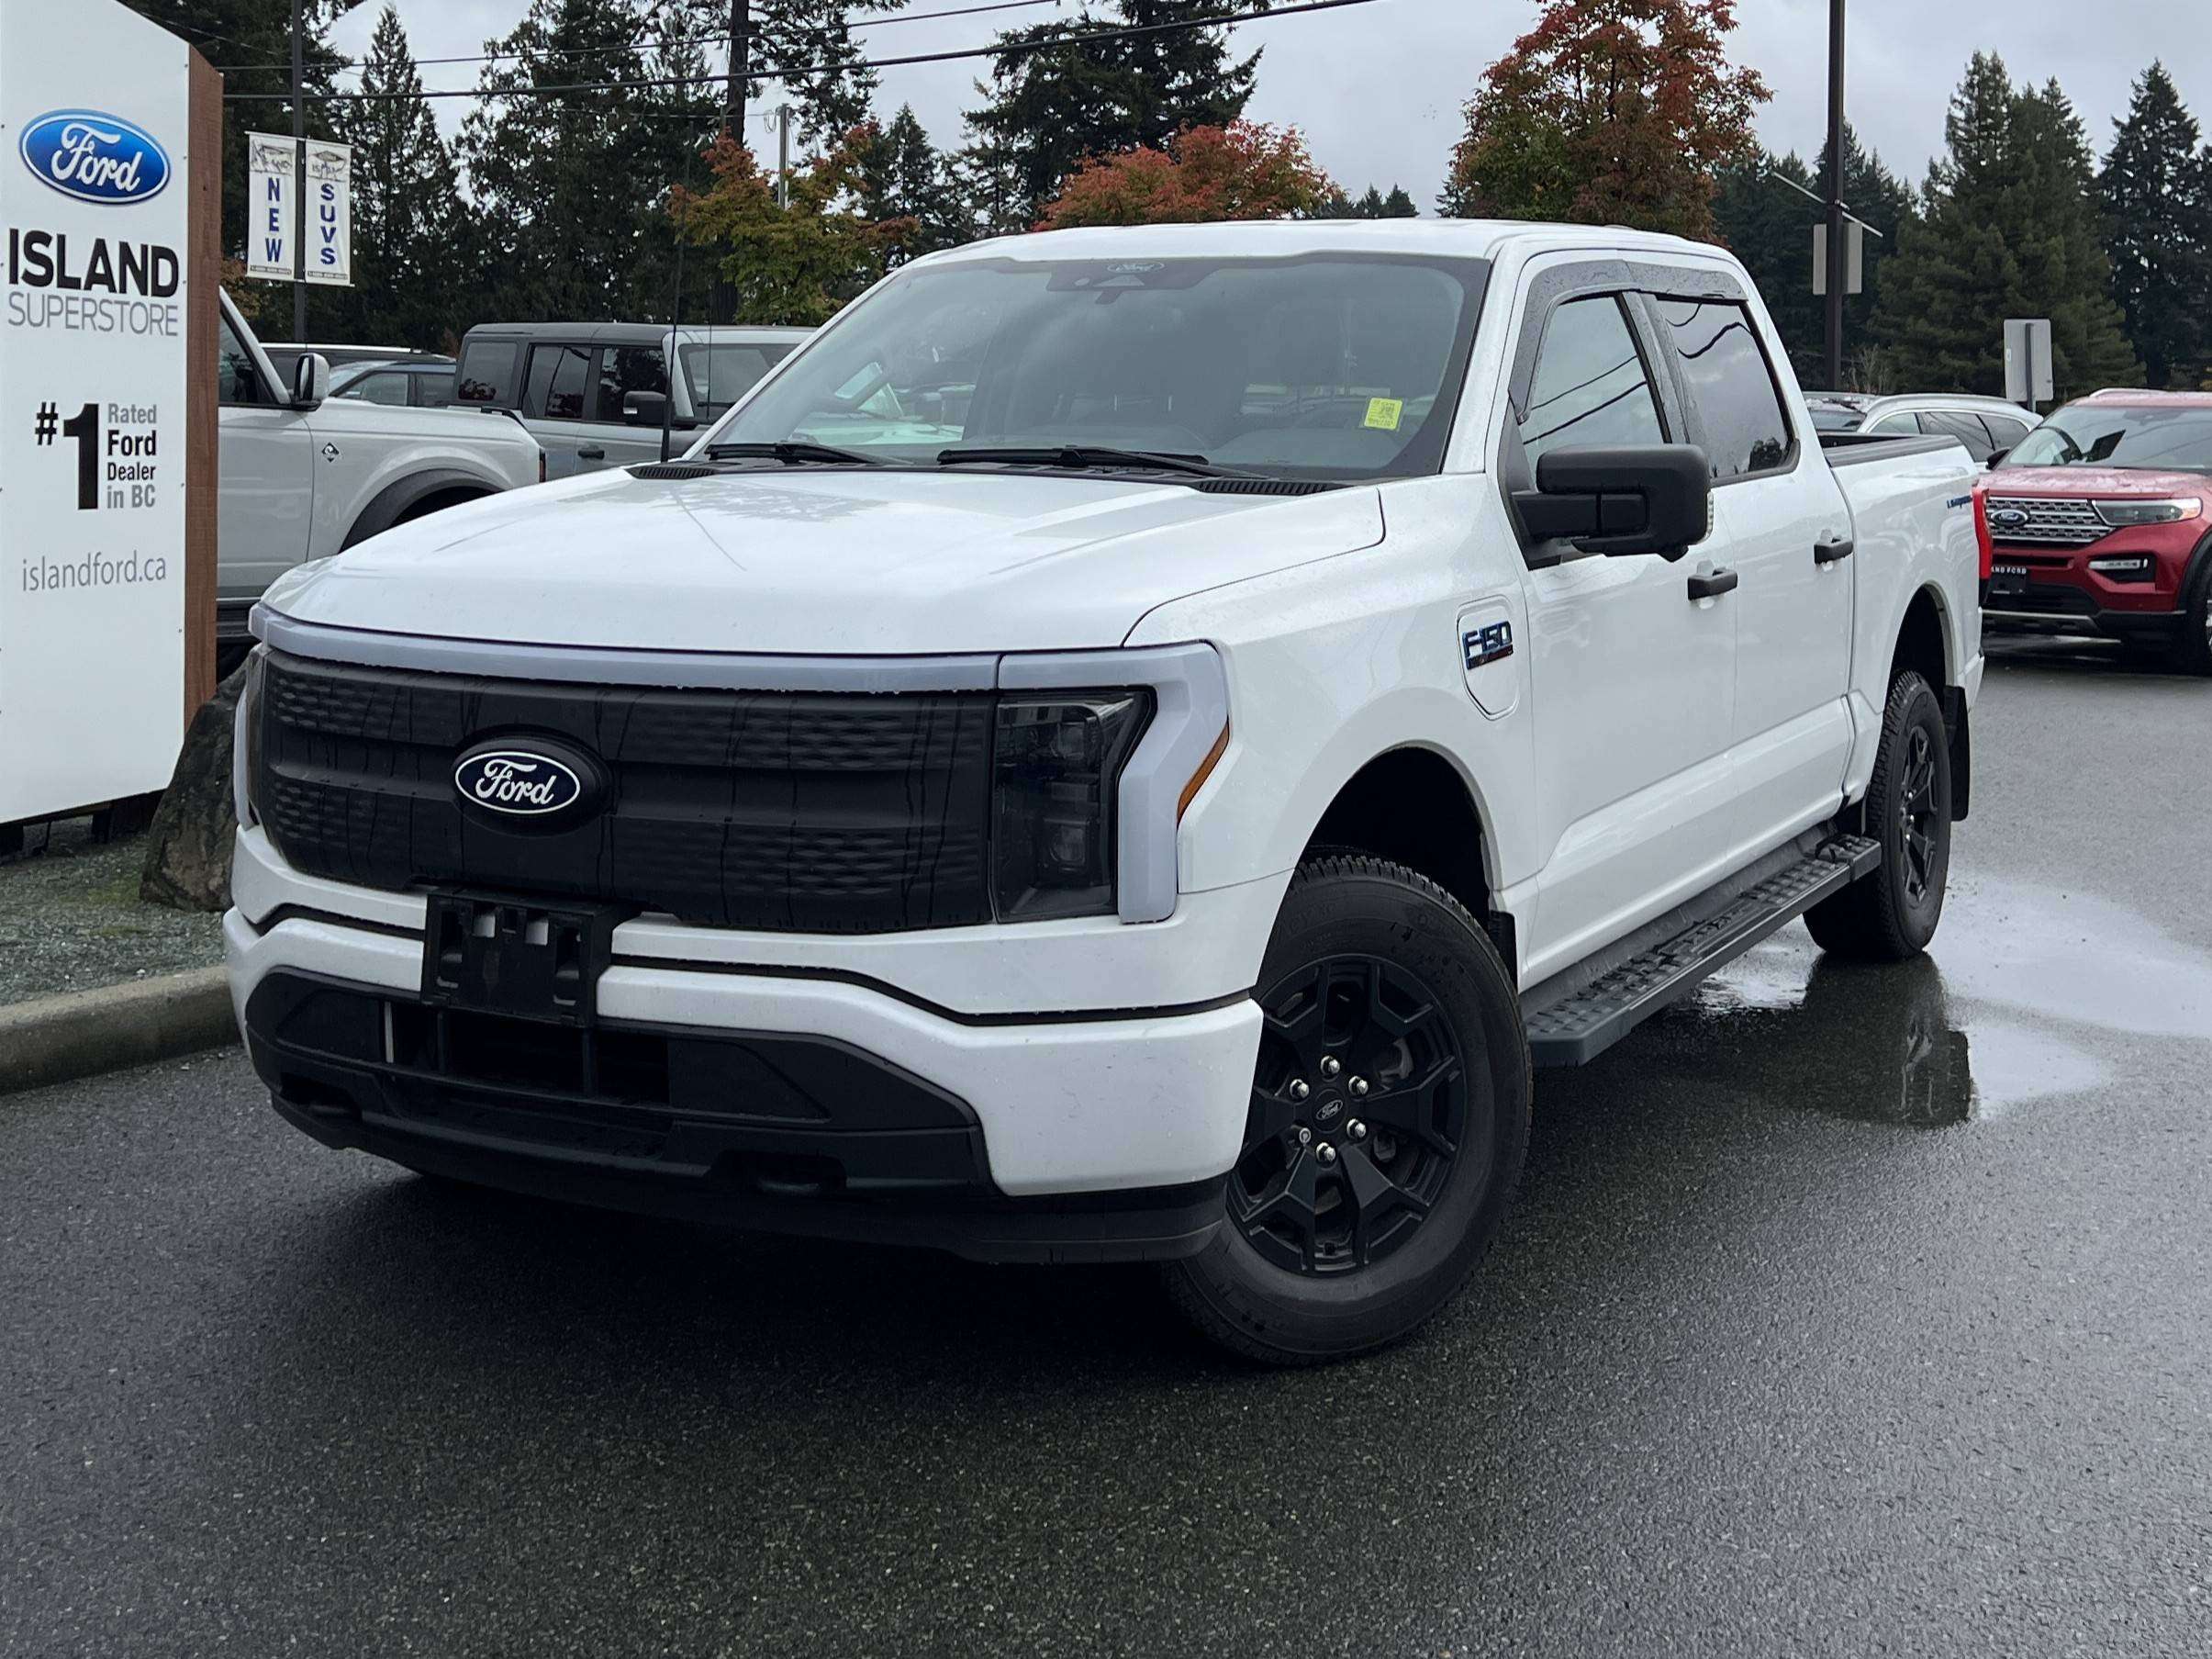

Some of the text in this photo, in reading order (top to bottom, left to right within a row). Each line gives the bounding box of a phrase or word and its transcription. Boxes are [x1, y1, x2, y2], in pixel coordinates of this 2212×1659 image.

[50, 122, 144, 192] Ford
[264, 176, 283, 263] NEW
[319, 183, 337, 265] SUVS
[8, 227, 180, 298] ISLAND
[7, 291, 179, 337] SUPERSTORE
[107, 403, 158, 424] Rated
[34, 401, 99, 510] #1
[107, 429, 157, 457] Ford
[106, 462, 156, 482] Dealer
[106, 484, 156, 509] in BC
[22, 549, 167, 592] islandford.ca
[475, 758, 557, 805] Ford
